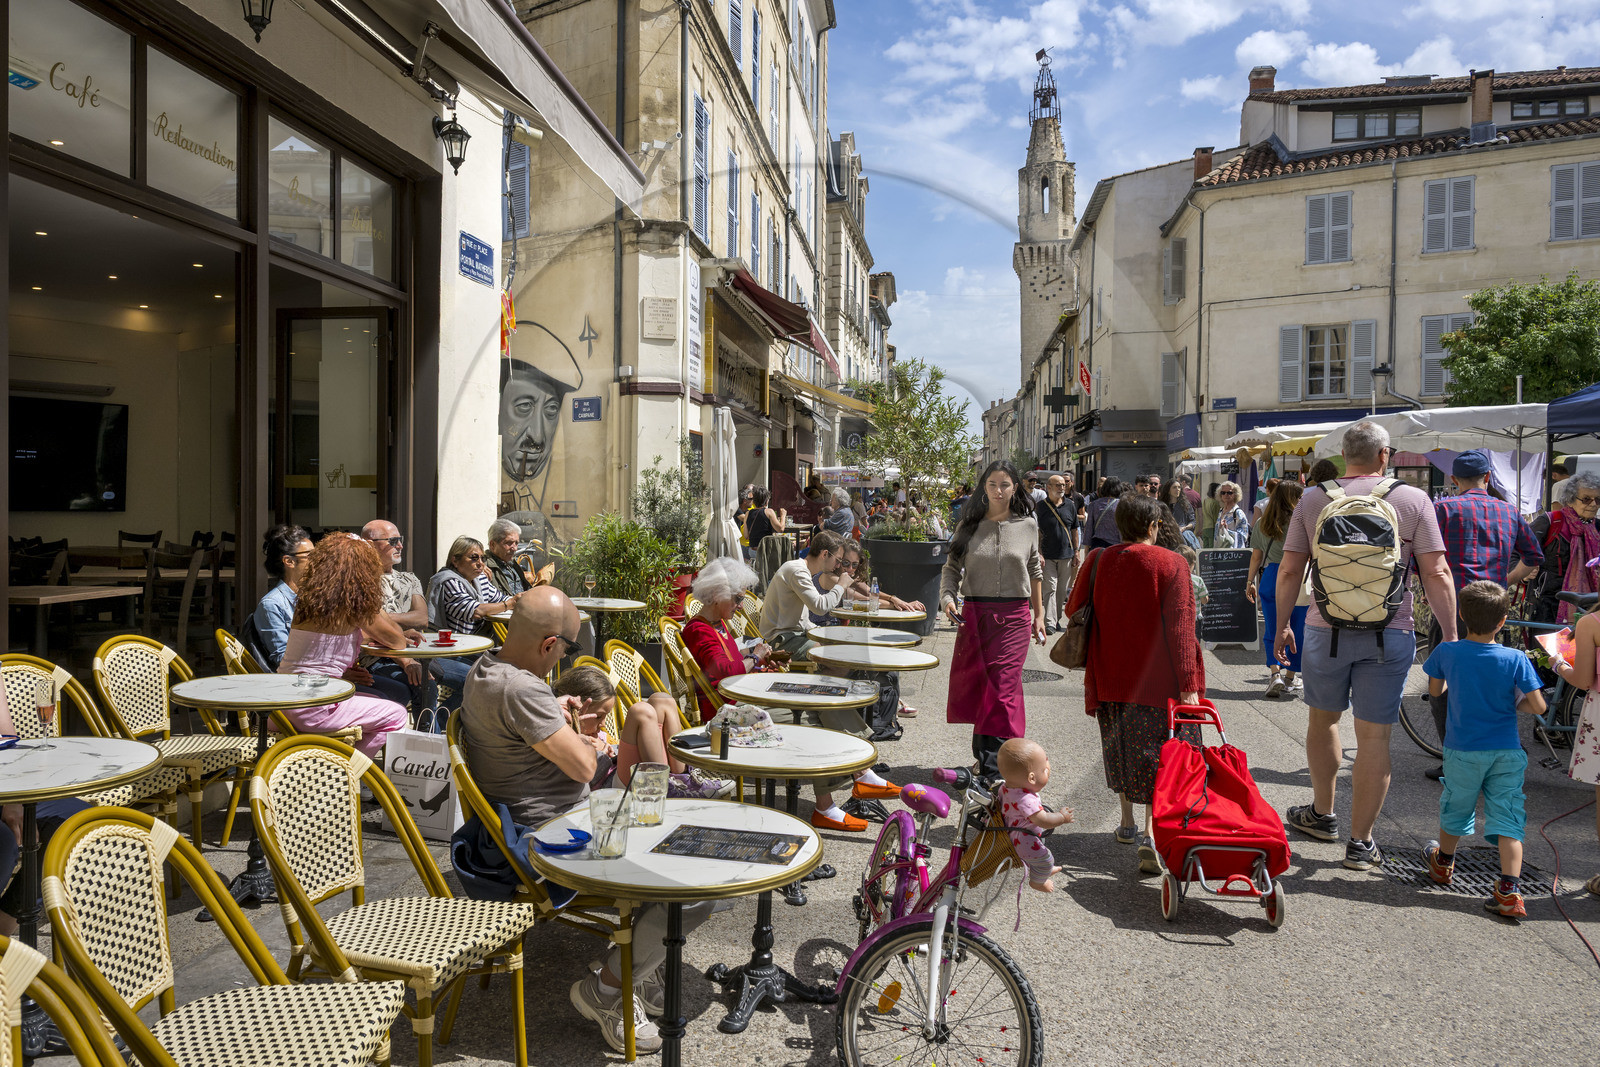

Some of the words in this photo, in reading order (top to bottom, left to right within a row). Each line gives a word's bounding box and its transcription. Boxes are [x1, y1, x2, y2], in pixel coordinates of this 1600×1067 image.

[49, 62, 101, 108] Café
[154, 112, 237, 171] Restauration
[466, 239, 474, 248] RUE
[477, 244, 488, 256] PLACE
[391, 755, 452, 780] Cardel
